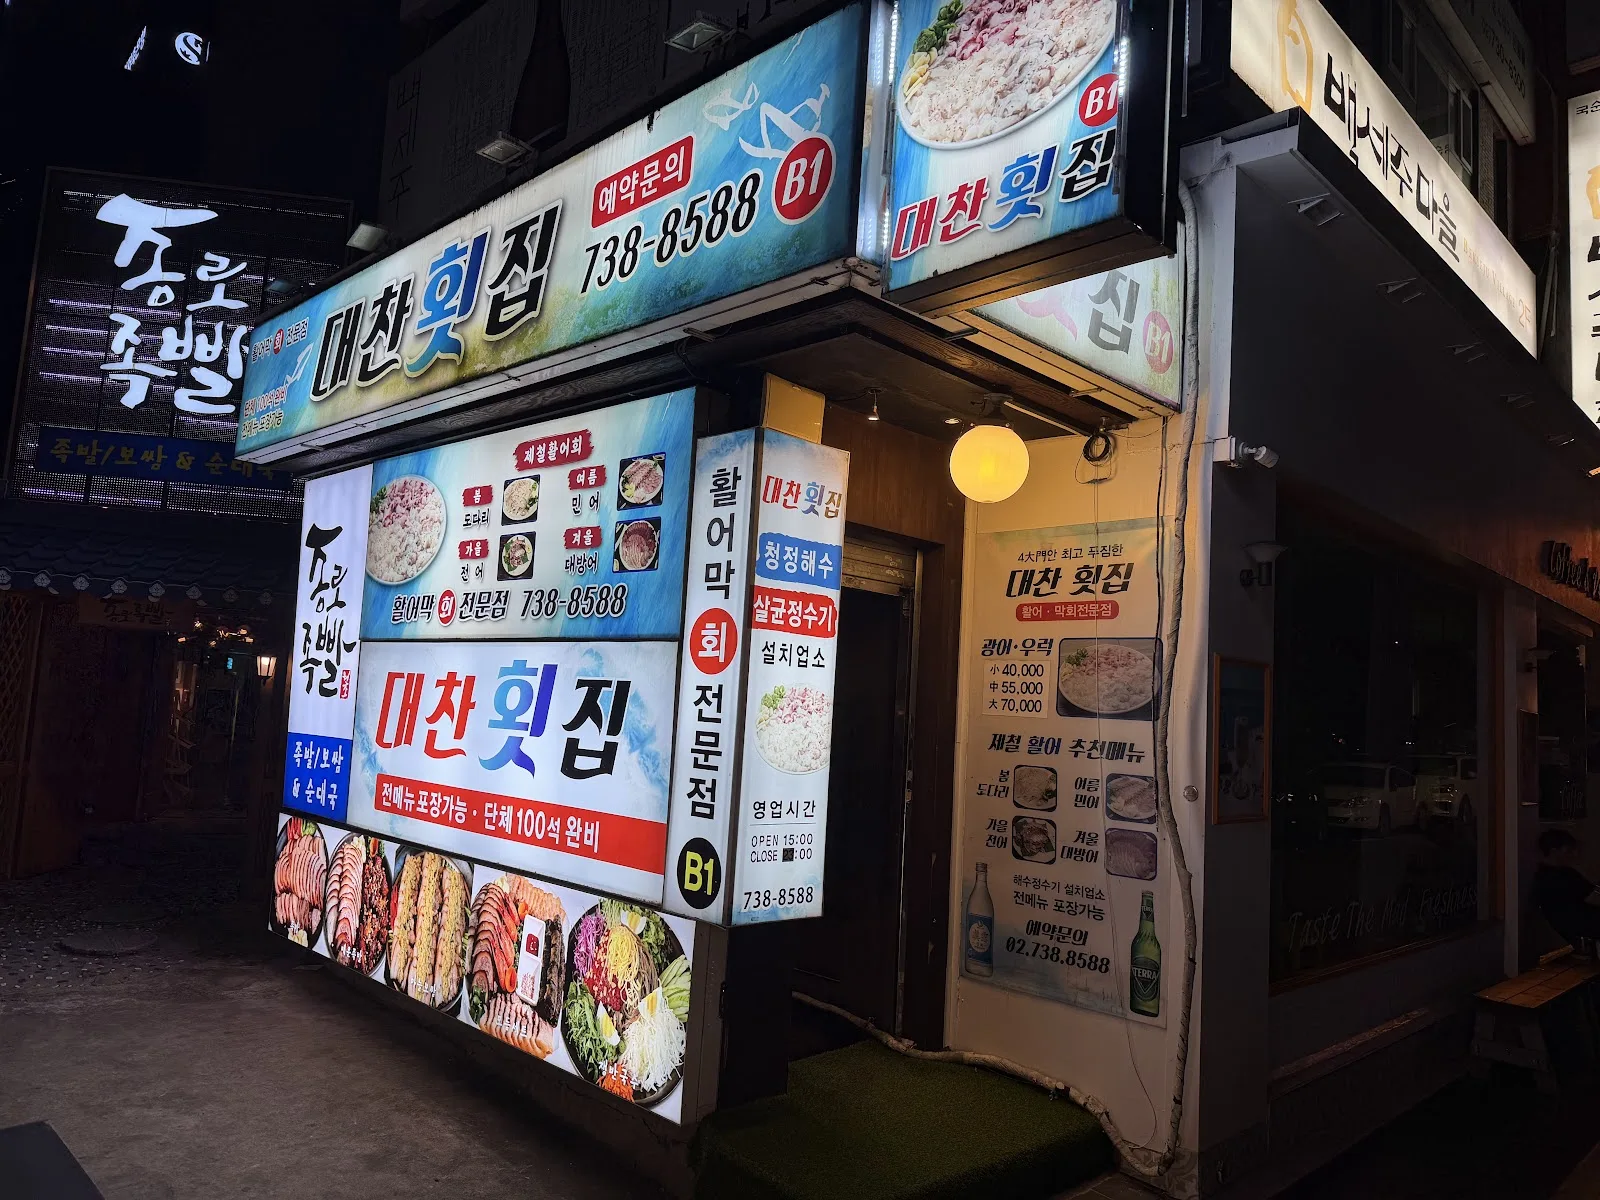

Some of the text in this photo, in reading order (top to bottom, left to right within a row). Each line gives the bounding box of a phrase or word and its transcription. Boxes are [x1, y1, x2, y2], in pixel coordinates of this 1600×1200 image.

[1084, 84, 1118, 121] B1
[1324, 53, 1460, 263] 백세주마을
[598, 145, 686, 215] 예약문의
[780, 148, 829, 208] B1
[892, 130, 1116, 261] 대찬횟집
[581, 172, 763, 296] 738-8588
[96, 194, 249, 312] 종로
[312, 200, 563, 401] 대찬횟집
[1518, 298, 1532, 328] 2F
[274, 330, 284, 352] 회
[286, 317, 309, 347] 전문점
[1144, 322, 1172, 365] B1
[524, 435, 583, 465] 제철활어회
[473, 469, 597, 502] 봄 여름
[762, 475, 843, 519] 대찬횟집
[462, 508, 490, 528] 도다리
[704, 466, 742, 600] 활어막
[465, 529, 594, 557] 가을 겨울
[763, 540, 834, 580] 청정해수
[1061, 547, 1084, 560] 최고
[305, 523, 348, 613] 종로
[564, 554, 599, 575] 대방어
[1005, 562, 1135, 598] 대찬 횟집
[392, 584, 626, 623] 활어막 회 전문점 738-8588
[753, 594, 833, 633] 살균정수기
[1021, 602, 1112, 620] 활어 막회전문점
[697, 621, 728, 664] 회
[761, 640, 826, 669] 설치업소
[989, 680, 1043, 695] 中 55,000
[990, 663, 1044, 678] 小 40,000
[375, 659, 632, 780] 대찬횟집
[988, 698, 1042, 714] 大 70,000
[293, 740, 345, 774] 족발/보쌈
[686, 684, 724, 821] 전문점
[988, 733, 1145, 763] 제철 활어 추천메뉴
[292, 777, 338, 811] & 순대국
[753, 800, 816, 820] 영업시간
[976, 783, 1100, 809] 도다리 민어
[382, 782, 600, 853] 전메뉴 포장가능 단체 100석 완비
[750, 849, 778, 863] CLOSE
[751, 833, 813, 848] OPEN 15:00
[985, 834, 1099, 863] 전어 대방어
[683, 849, 715, 897] B1
[1013, 874, 1106, 901] 해수정수기 설치업소
[743, 886, 815, 911] 738-8588
[1013, 890, 1105, 921] 전메뉴 포장가능
[1025, 919, 1089, 946] 예약문의
[1288, 904, 1342, 952] Taste
[1006, 936, 1110, 974] 02.738.8588
[1132, 966, 1157, 980] TERRA
[598, 1059, 639, 1089] 쟁반국수
